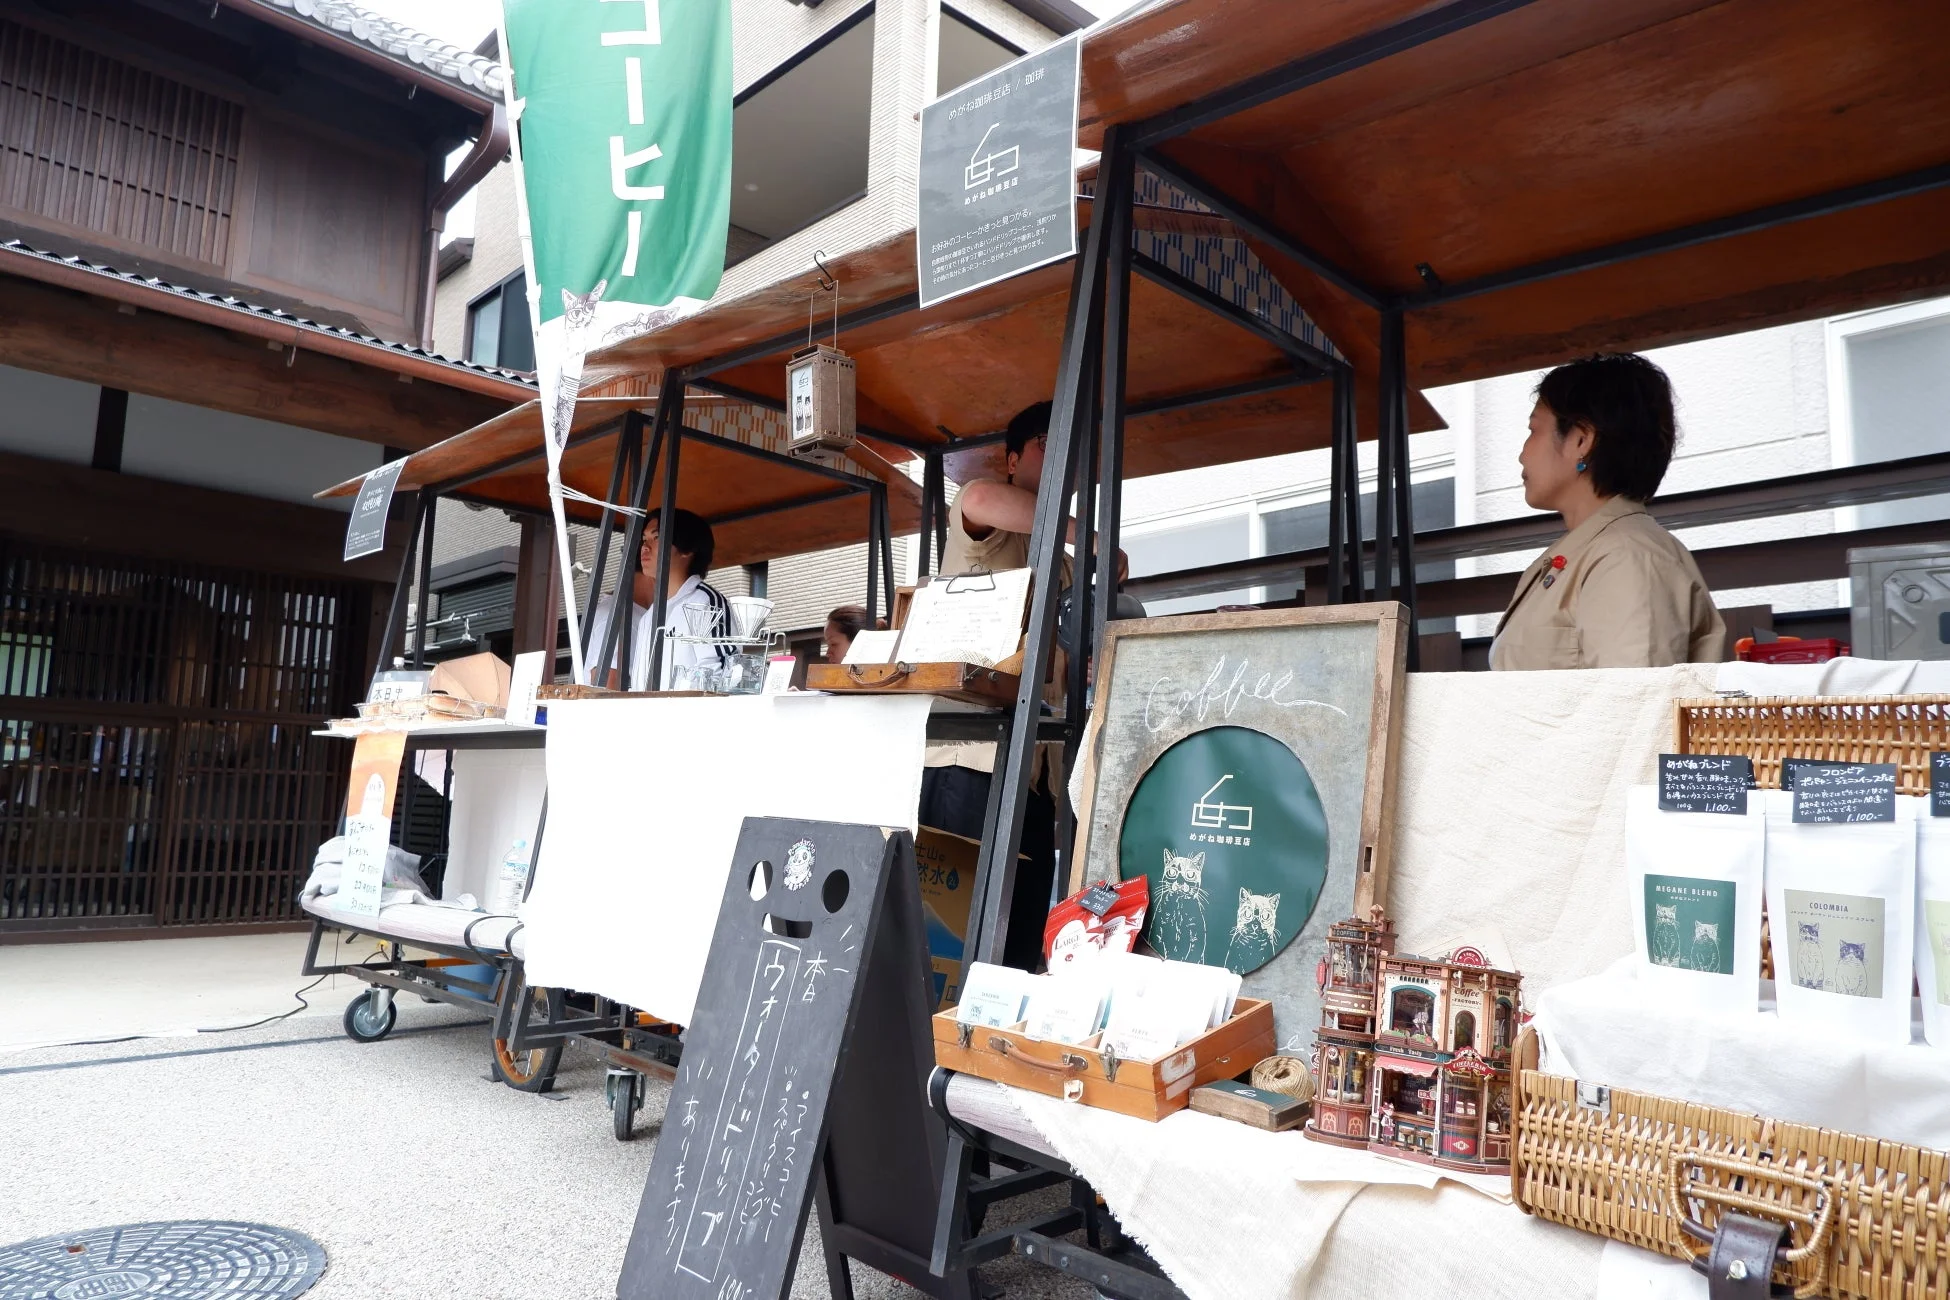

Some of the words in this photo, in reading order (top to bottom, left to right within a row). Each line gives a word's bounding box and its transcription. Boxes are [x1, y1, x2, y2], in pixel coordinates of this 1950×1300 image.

[948, 83, 1011, 121] めがね珈琲豆店
[1025, 67, 1045, 86] 珈琲
[601, 0, 665, 276] コーヒー
[964, 176, 1019, 206] めがね珈琲豆店
[1666, 758, 1732, 771] めがねブレンド
[1189, 832, 1251, 847] めがね珈琲豆店
[1655, 885, 1689, 896] MEGANE
[1691, 887, 1718, 898] BLEND
[1809, 901, 1849, 913] COLOMBIA
